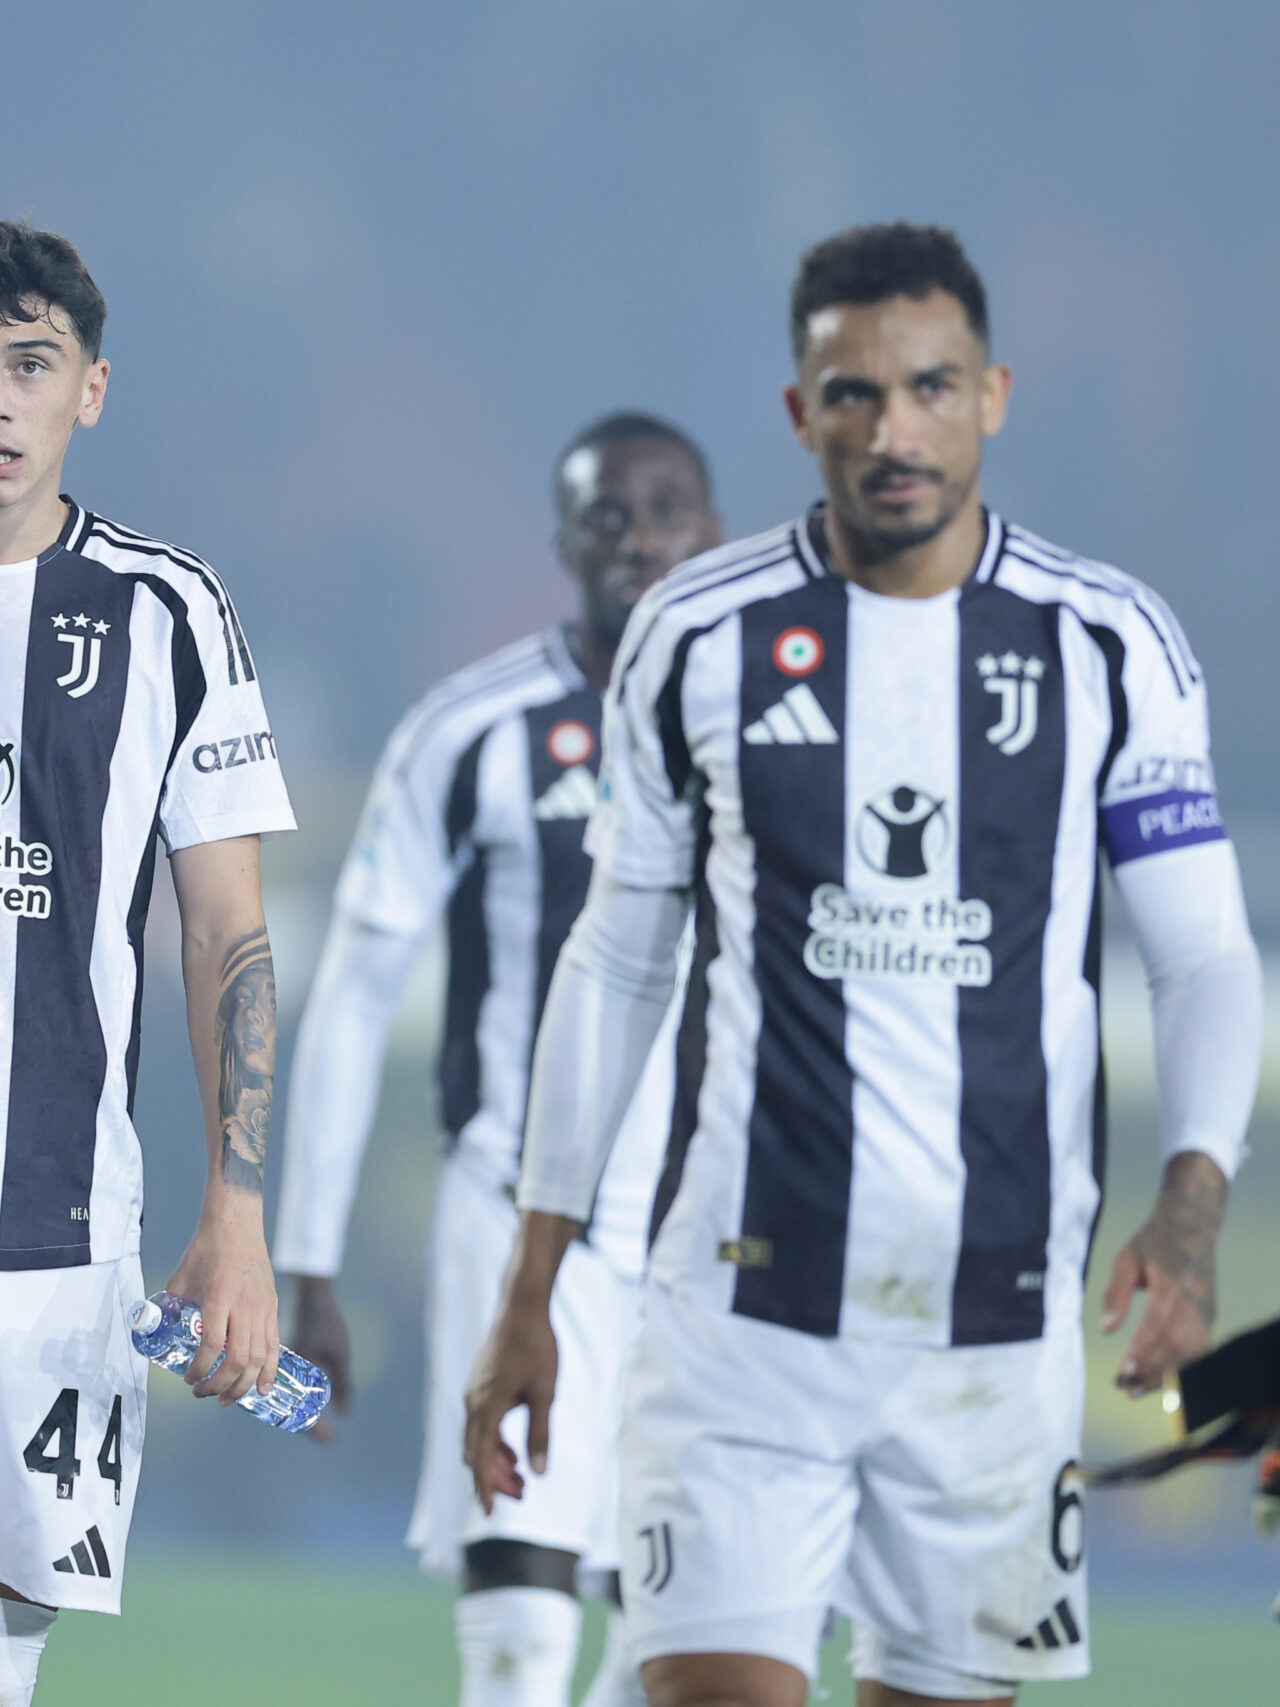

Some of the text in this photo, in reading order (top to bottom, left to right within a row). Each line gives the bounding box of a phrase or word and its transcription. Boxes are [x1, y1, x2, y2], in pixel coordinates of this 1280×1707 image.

[819, 890, 983, 932] Save the
[813, 936, 984, 976] Children
[22, 1387, 122, 1506] 44
[1051, 1459, 1083, 1573] 6
